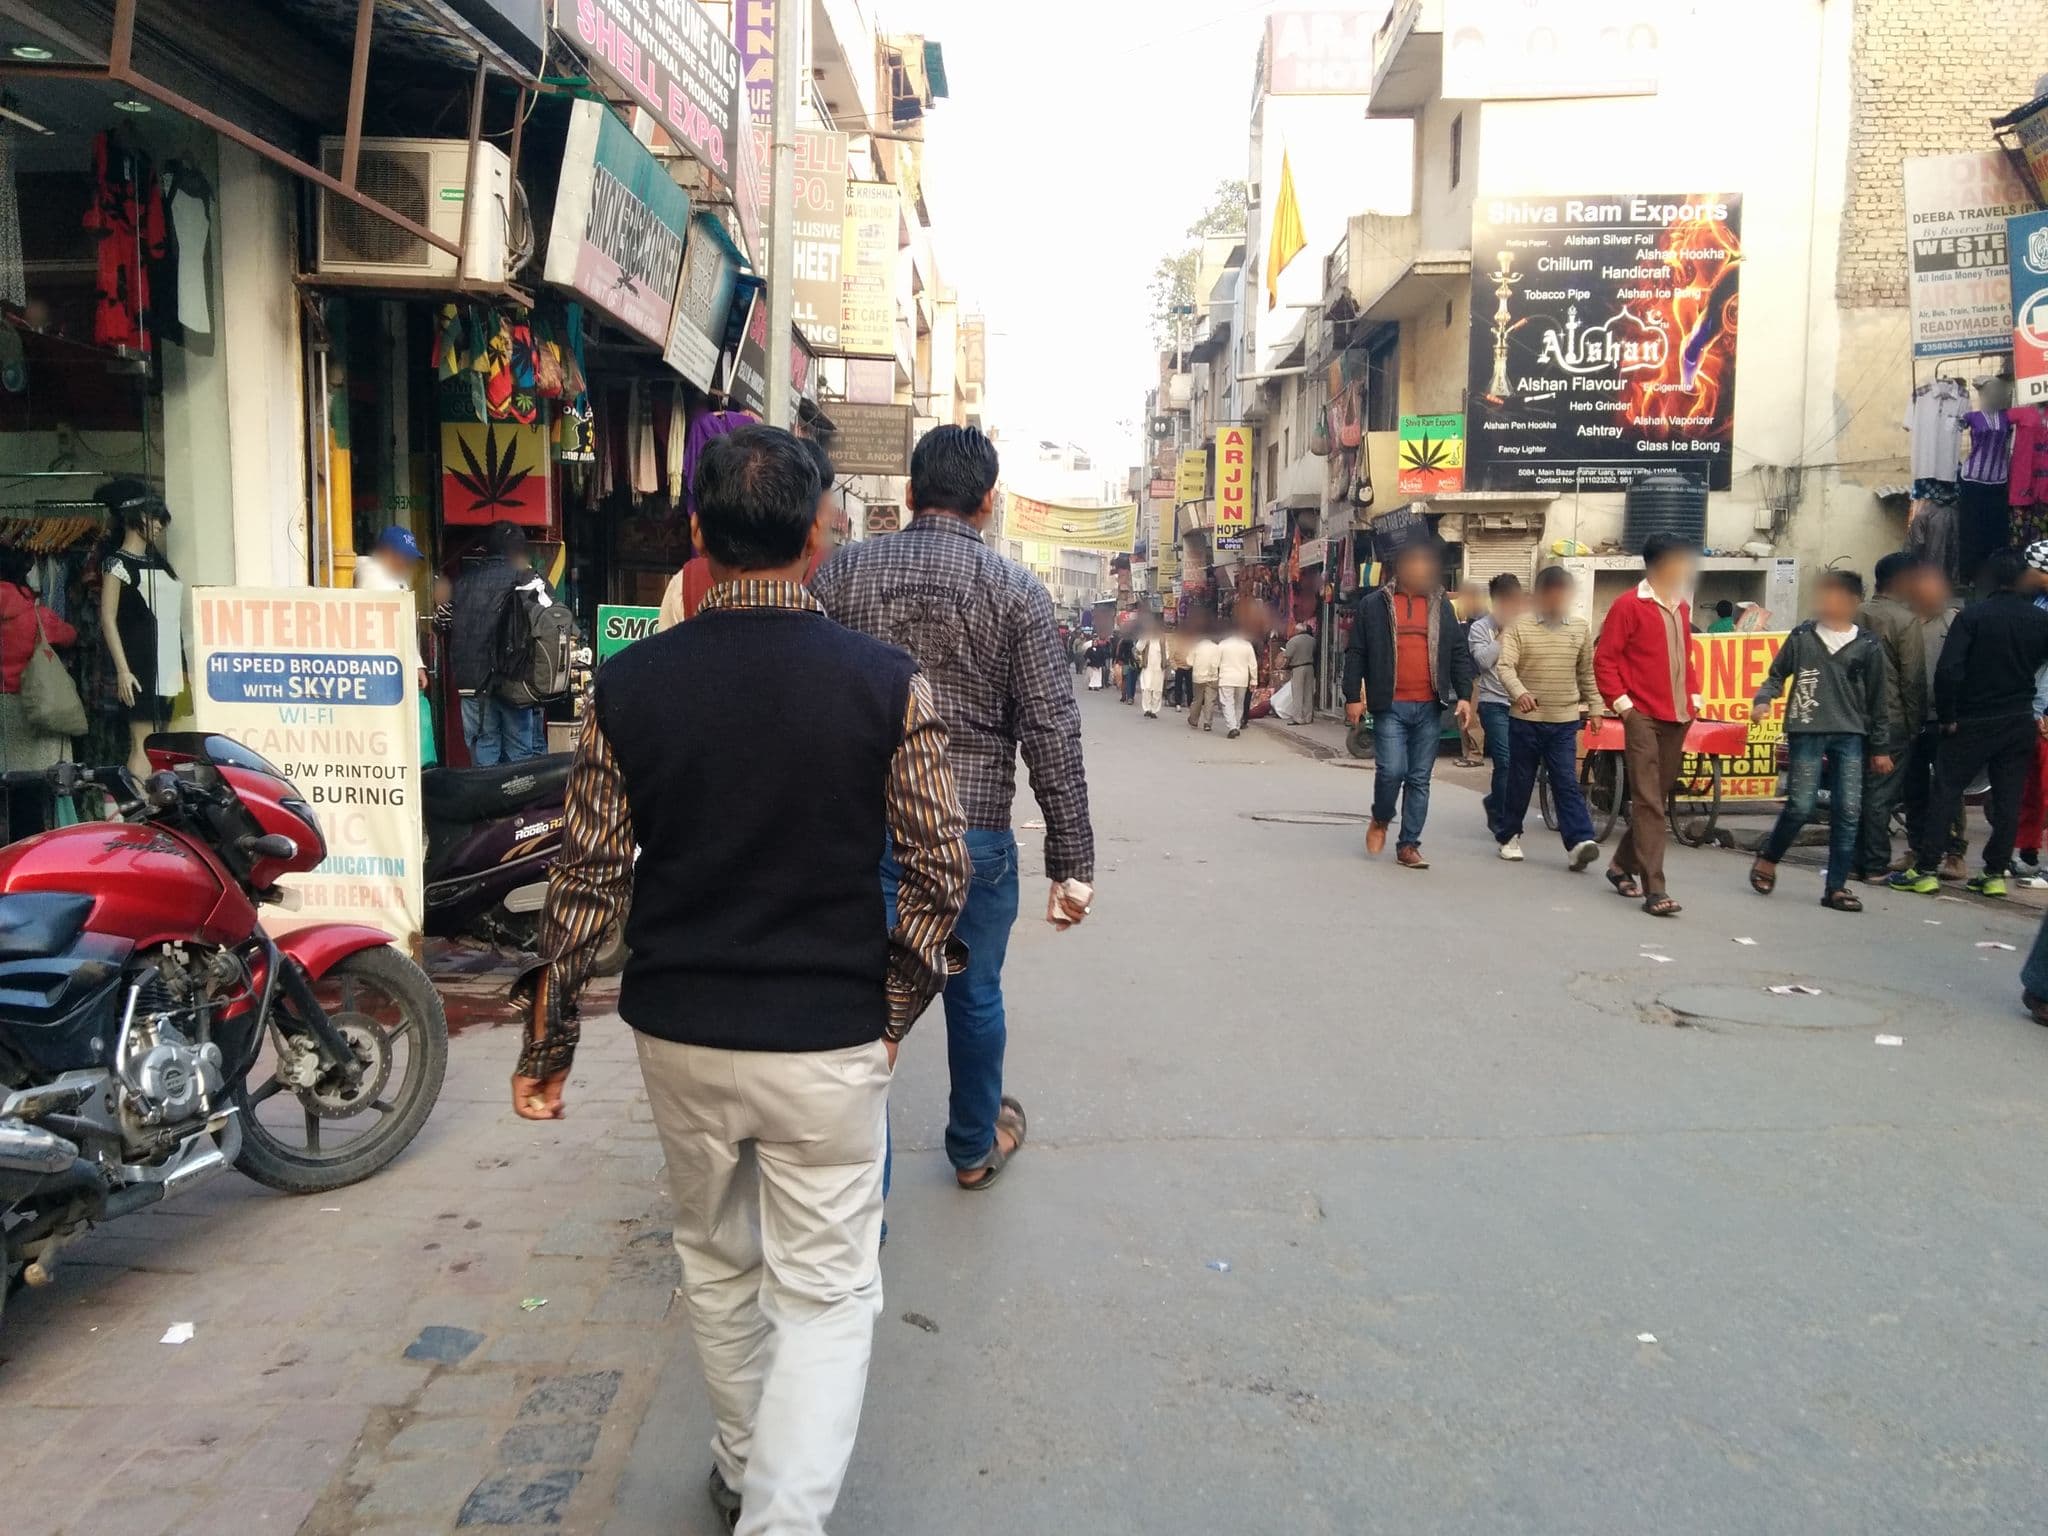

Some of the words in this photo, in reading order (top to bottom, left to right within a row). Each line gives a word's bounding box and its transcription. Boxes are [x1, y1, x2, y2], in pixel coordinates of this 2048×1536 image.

[655, 14, 698, 69] INCENSE
[698, 60, 729, 106] STICKS
[710, 33, 737, 90] OILS
[633, 23, 681, 82] NATURAL
[682, 69, 729, 130] PRODUCTS
[576, 0, 662, 112] SHELL
[668, 79, 729, 175] EXPO.
[752, 129, 843, 173] SELL
[857, 187, 893, 200] KRISHNA
[1487, 201, 1559, 224] Shiva
[1566, 201, 1622, 223] Ram
[1630, 199, 1728, 227] Exports
[1913, 211, 1955, 224] DEEBA
[1959, 204, 2017, 220] TRAVELS
[1564, 235, 1600, 246] Alshan
[1602, 234, 1632, 246] Silver
[1635, 234, 1654, 245] Foil
[1636, 249, 1677, 260] Alshan
[1680, 248, 1725, 259] Hookha
[1957, 249, 2006, 267] UNI
[1537, 256, 1593, 272] Chillum
[1602, 266, 1671, 279] Handicraft
[1918, 274, 1929, 283] All
[1931, 272, 1952, 282] India
[1955, 270, 1983, 281] Money
[1524, 289, 1565, 300] Tobacco
[1567, 289, 1590, 301] Pipe
[1617, 288, 1653, 299] Alshan
[1655, 288, 1672, 299] Ice
[842, 307, 857, 321] ET
[861, 308, 889, 323] CAFE
[1971, 304, 1998, 313] Tickets
[1920, 315, 1999, 334] READYMADE
[1517, 377, 1567, 392] Alshan
[1572, 377, 1628, 392] Flavour
[1570, 401, 1592, 411] Herb
[1595, 401, 1632, 411] Grinder
[1421, 418, 1434, 427] Ram
[1436, 418, 1456, 428] Exports
[1483, 421, 1509, 430] Alshan
[1511, 421, 1526, 430] Pen
[1528, 421, 1557, 430] Hookha
[1634, 416, 1666, 425] Alshan
[1668, 416, 1714, 428] Vaporizer
[1576, 425, 1623, 440] Ashtray
[1499, 445, 1520, 455] Fancy
[1522, 445, 1547, 455] Lighter
[1637, 440, 1668, 451] Glass
[1671, 440, 1689, 451] Ice
[1691, 440, 1720, 453] Bong
[828, 450, 863, 462] HOTEL
[1223, 430, 1244, 521] ARJUN
[200, 599, 401, 650] INTERNET
[210, 658, 228, 673] HI
[233, 658, 285, 674] SPEED
[290, 659, 398, 676] BROADBAND
[1691, 638, 1786, 700] ONE
[243, 684, 283, 698] WITH
[288, 676, 368, 700] SKYPE
[278, 706, 334, 725] WI-FI
[1766, 722, 1785, 732] LT
[284, 762, 319, 780] B/W
[324, 763, 408, 780] PRINTOUT
[312, 786, 405, 806] BURINIG
[333, 882, 406, 909] REPAIR
